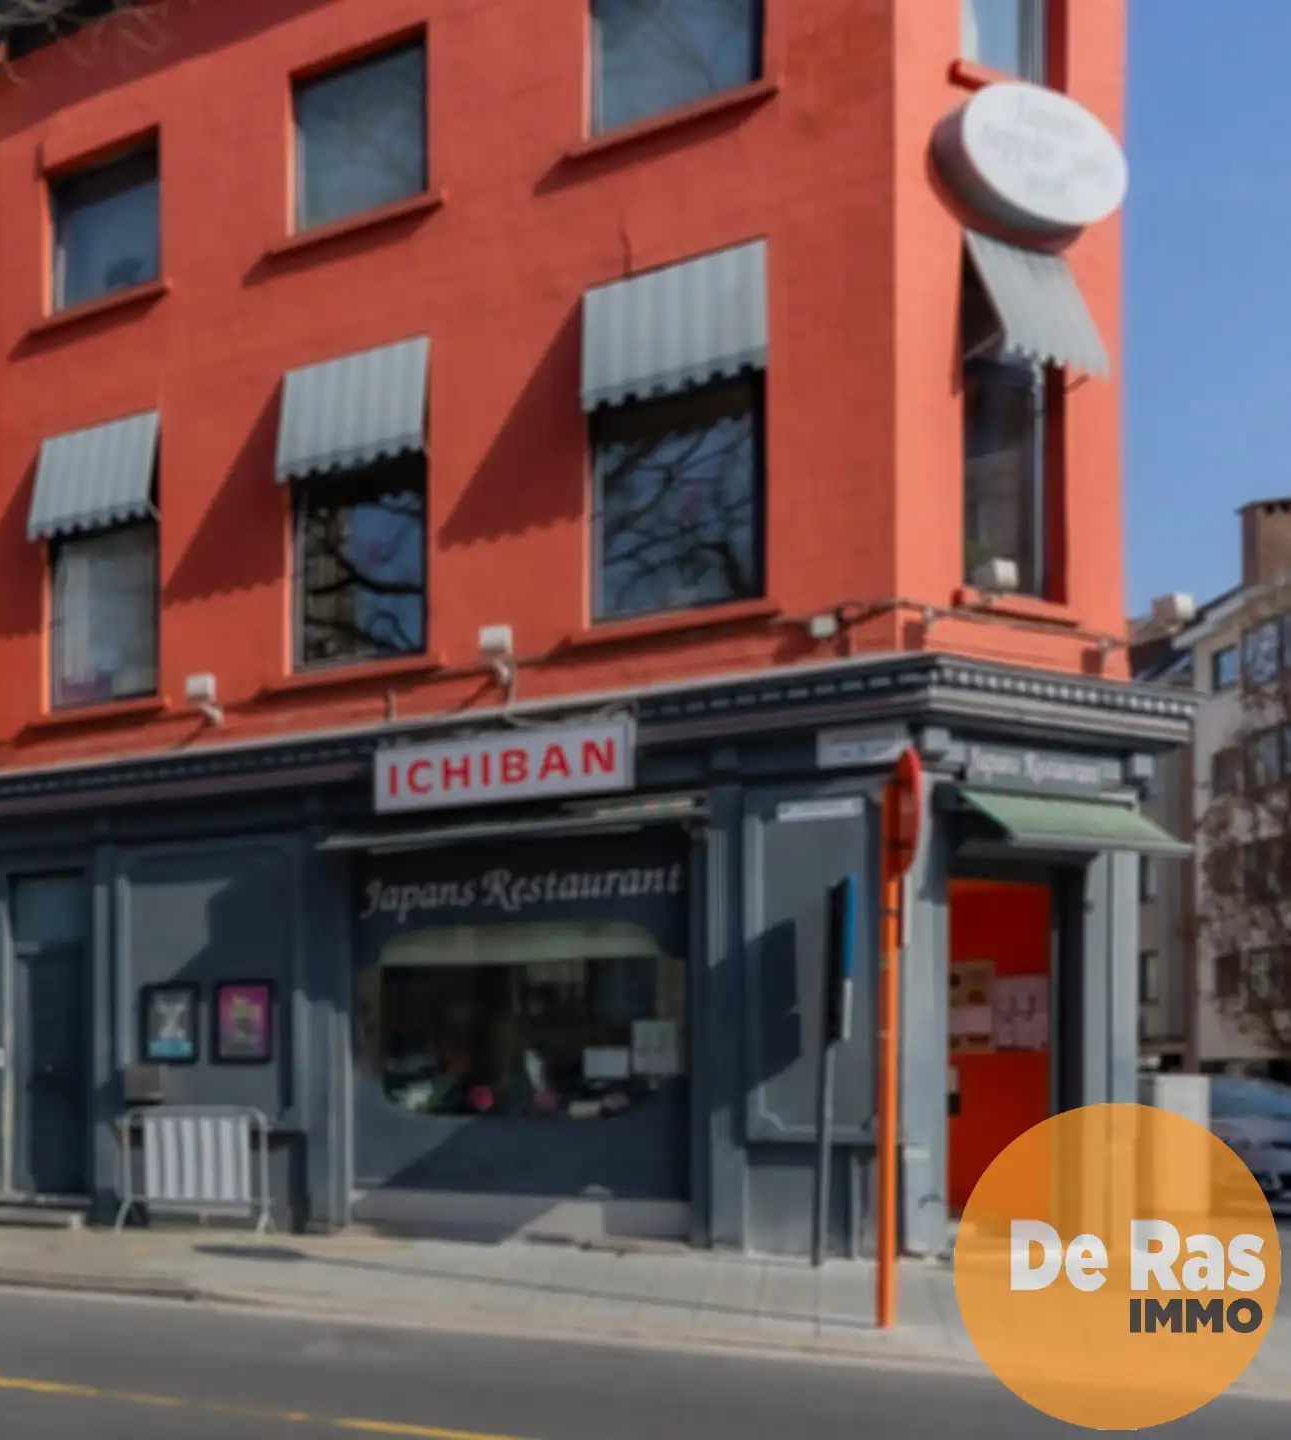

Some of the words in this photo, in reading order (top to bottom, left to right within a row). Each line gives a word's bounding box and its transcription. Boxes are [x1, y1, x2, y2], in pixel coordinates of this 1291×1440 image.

[388, 737, 615, 797] ICHIBAN
[362, 880, 476, 922] Japans
[480, 864, 682, 911] Restaurant
